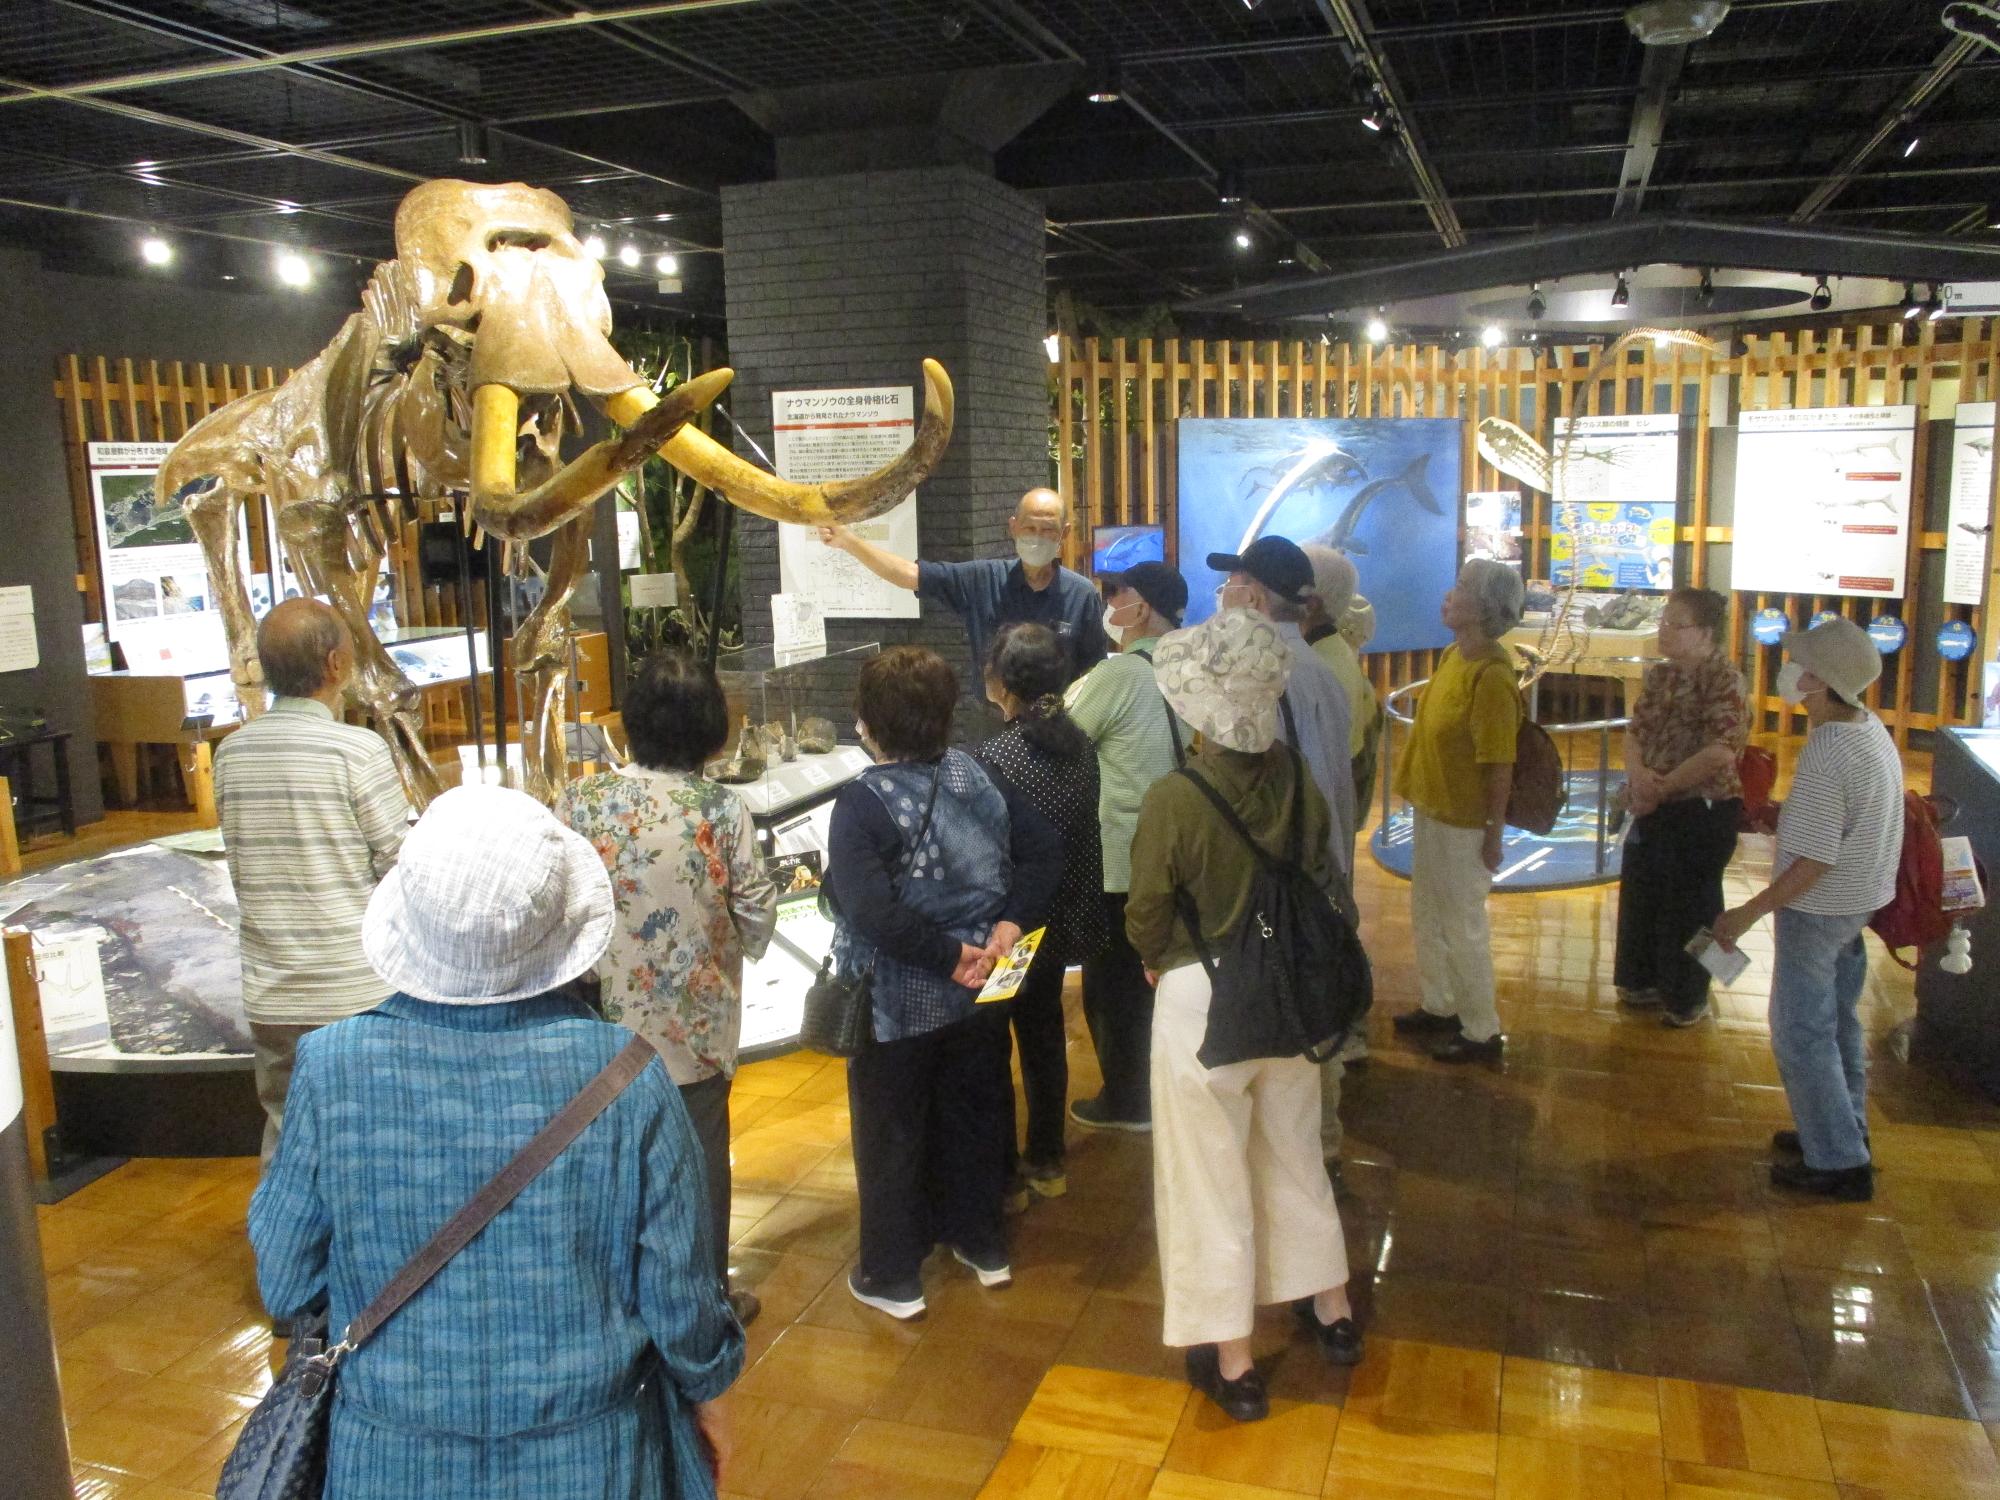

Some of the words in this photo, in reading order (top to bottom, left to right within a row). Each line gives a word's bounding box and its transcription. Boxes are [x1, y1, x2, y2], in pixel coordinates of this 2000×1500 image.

[786, 394, 899, 408] ナウマンゾウの全身骨格化石
